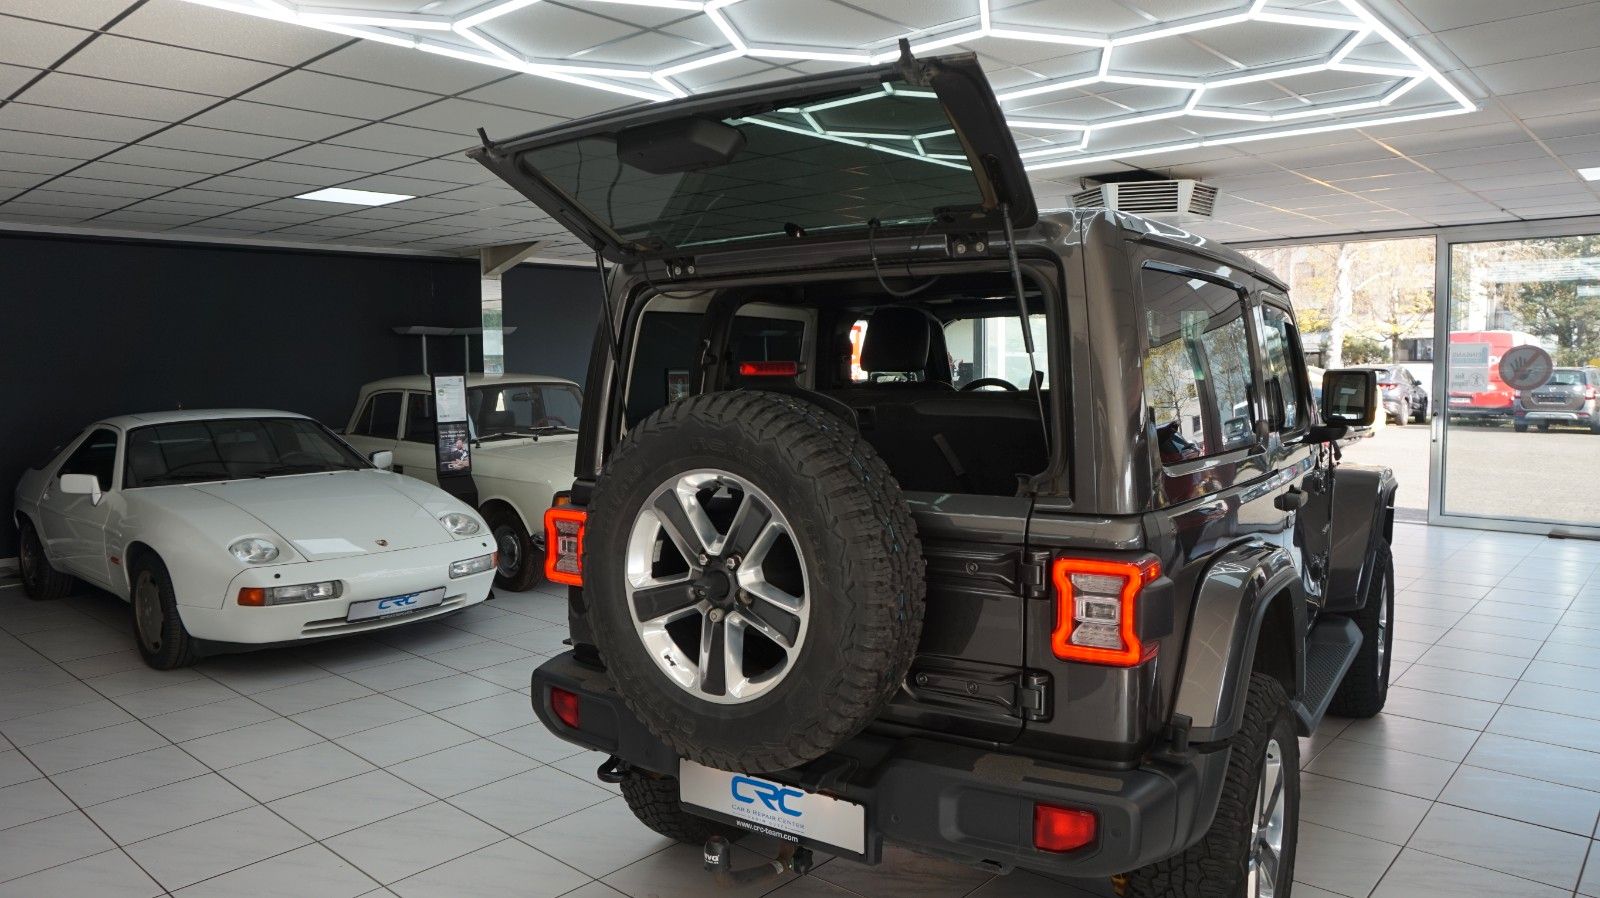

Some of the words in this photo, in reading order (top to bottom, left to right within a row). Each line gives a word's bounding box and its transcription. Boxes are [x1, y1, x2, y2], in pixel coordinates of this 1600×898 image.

[378, 593, 419, 610] CRC
[731, 775, 804, 817] CRC
[736, 820, 799, 843] www.crc-team.com
